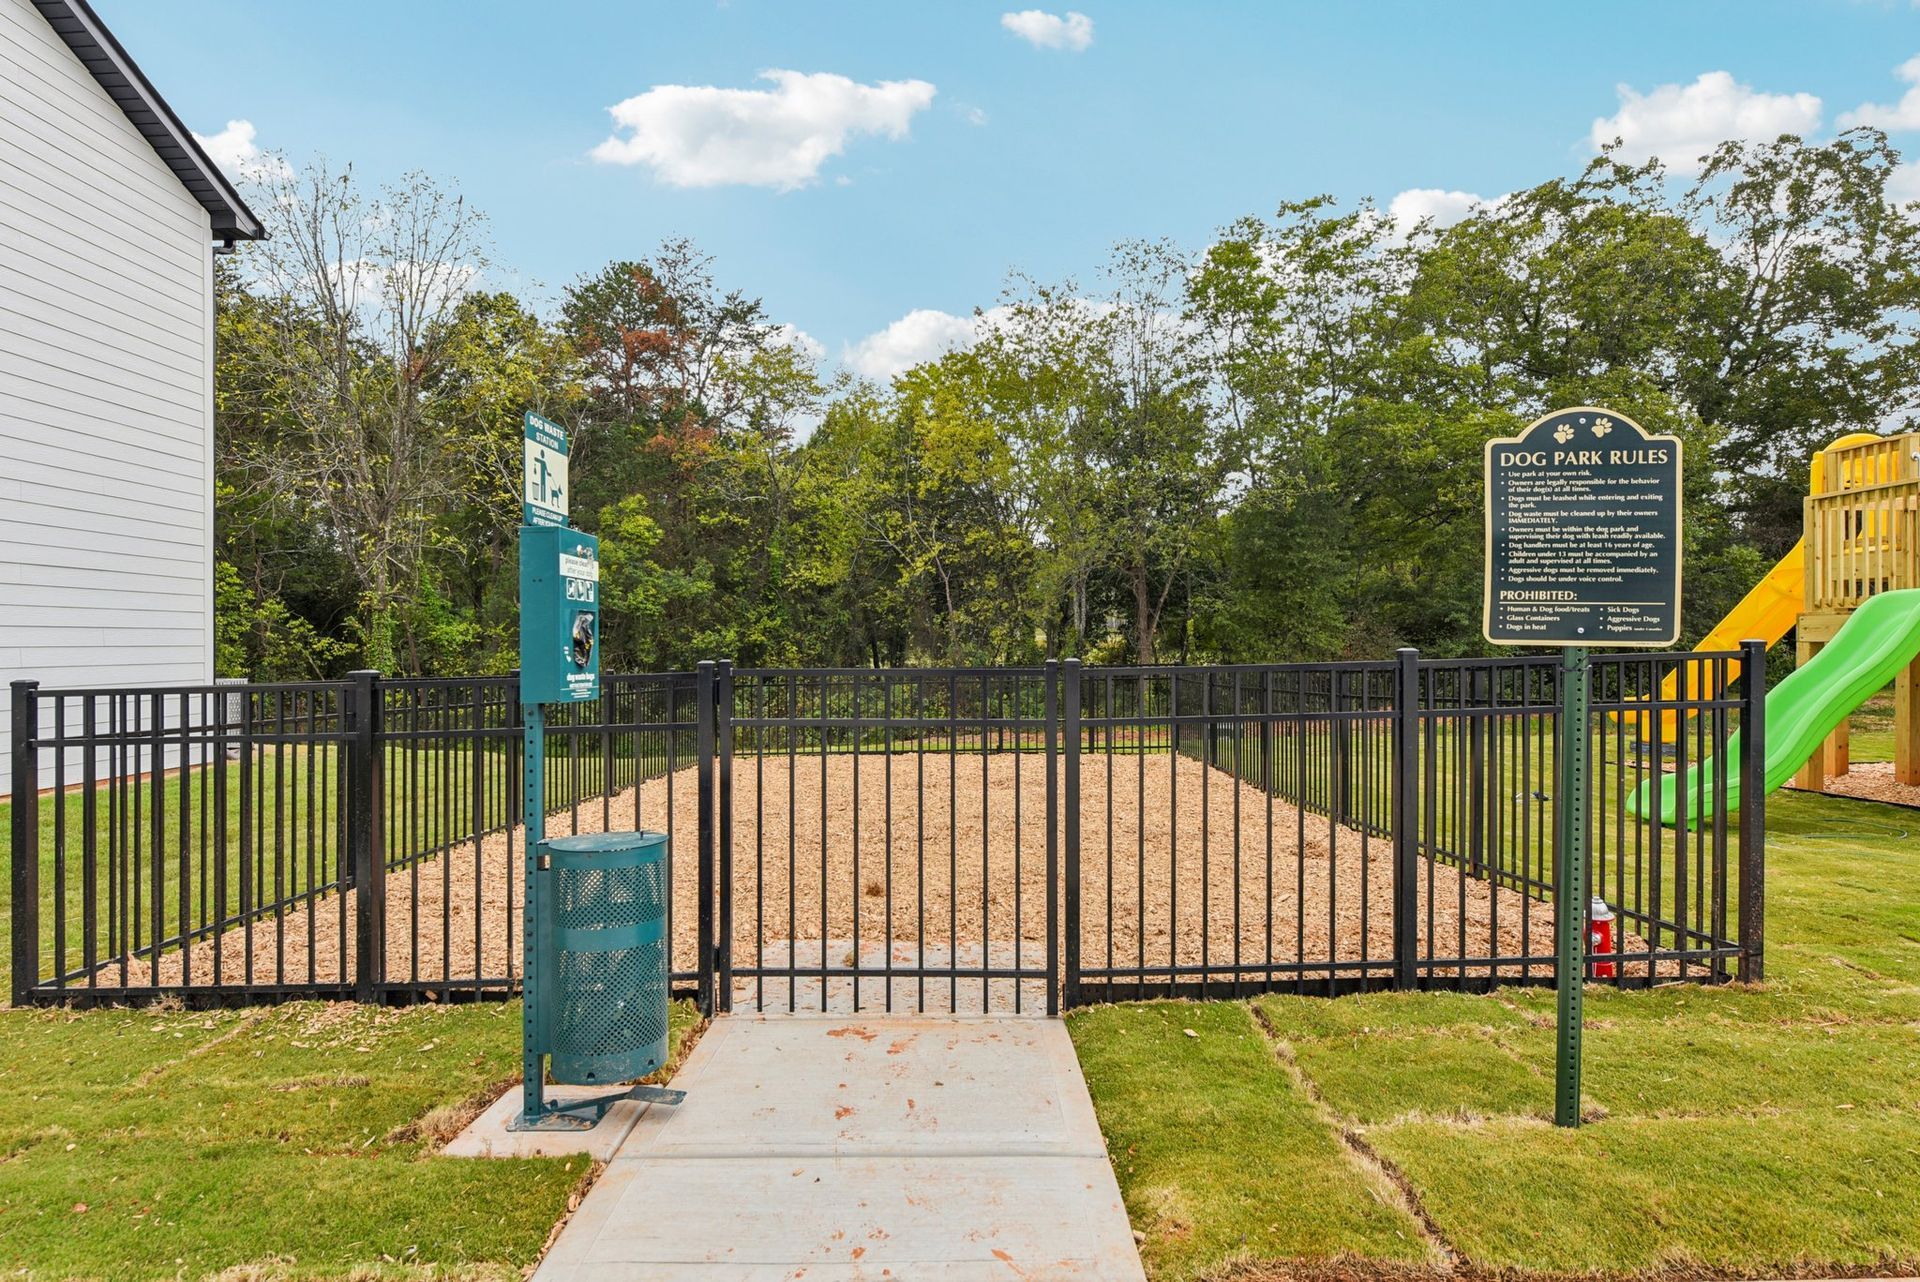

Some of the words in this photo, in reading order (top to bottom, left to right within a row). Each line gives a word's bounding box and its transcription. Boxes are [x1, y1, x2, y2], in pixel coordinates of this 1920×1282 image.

[530, 416, 544, 430] DOG
[544, 422, 564, 440] WASTE
[536, 432, 558, 450] STATION
[1500, 452, 1547, 466] DOG
[1554, 451, 1603, 465] PARK
[1610, 449, 1668, 464] RULES
[1500, 591, 1577, 600] PROHIBITED:
[566, 672, 575, 682] dog
[575, 673, 585, 681] waste
[586, 672, 595, 682] bags
